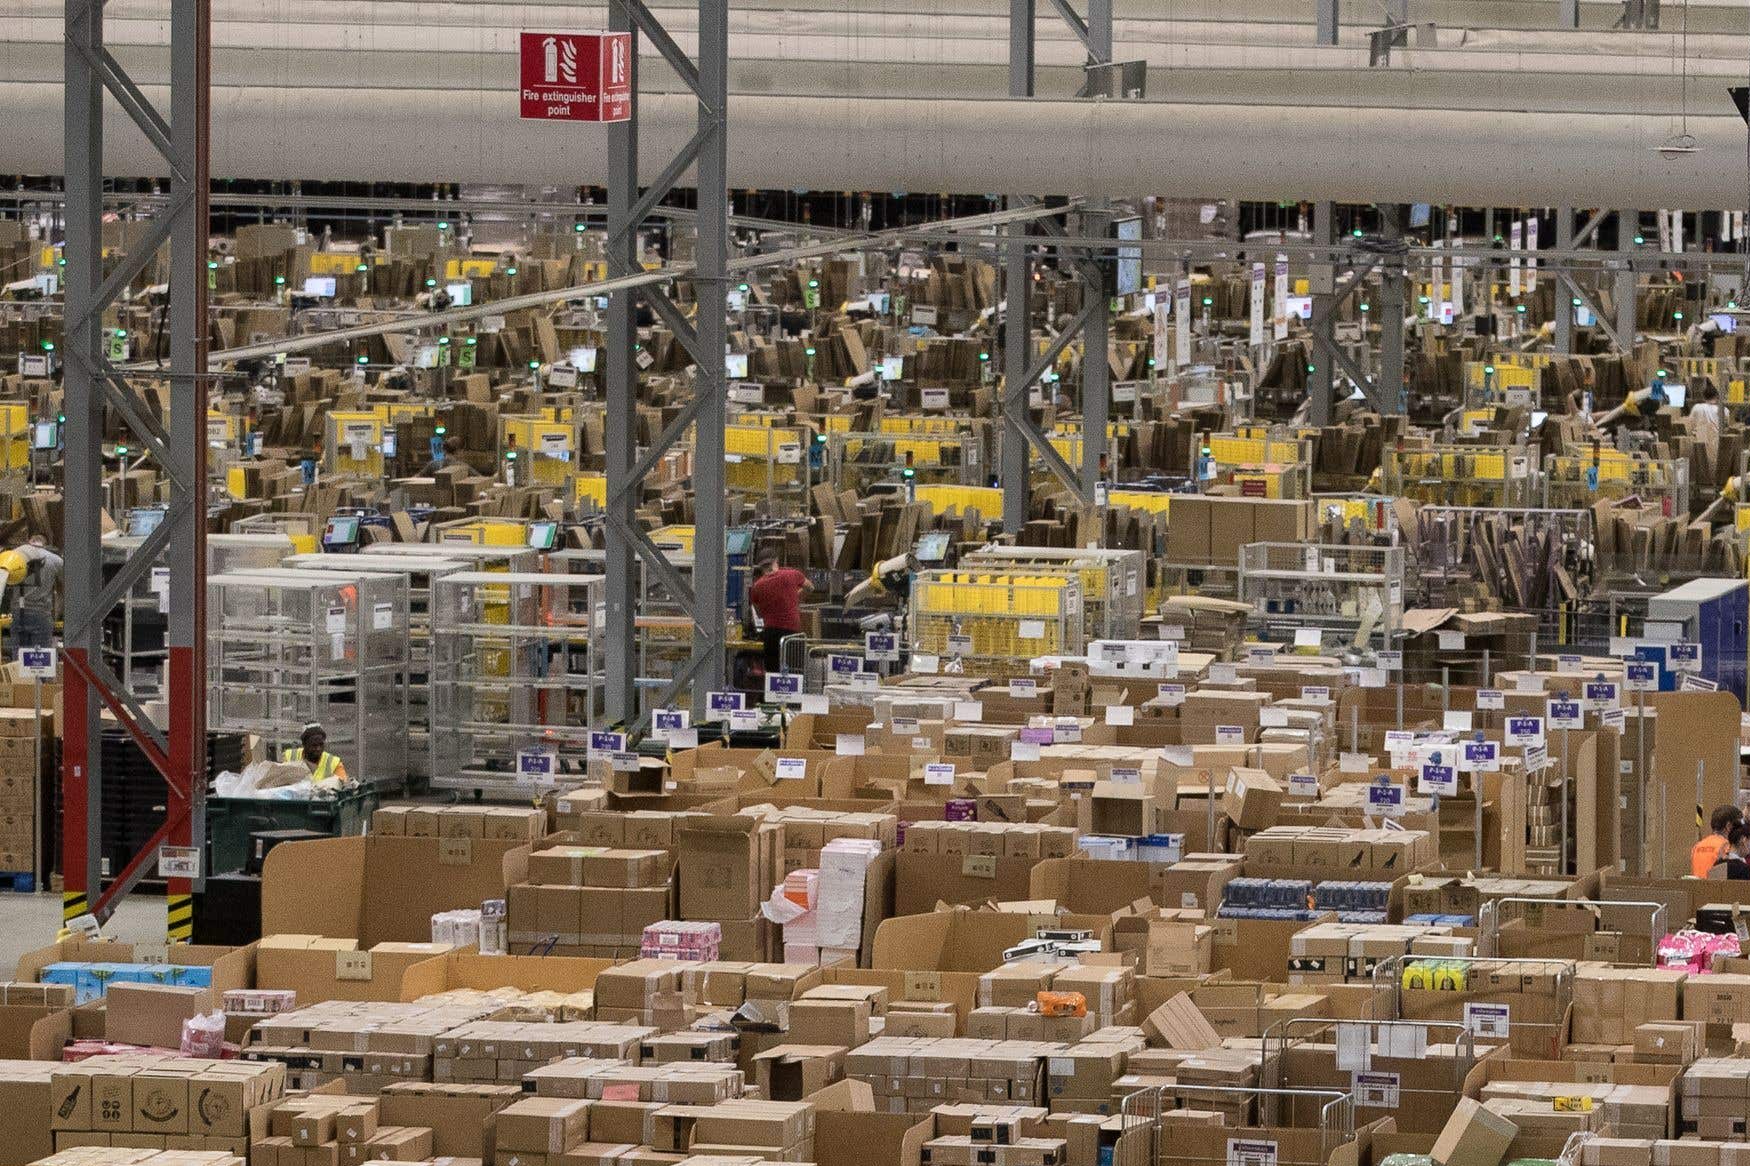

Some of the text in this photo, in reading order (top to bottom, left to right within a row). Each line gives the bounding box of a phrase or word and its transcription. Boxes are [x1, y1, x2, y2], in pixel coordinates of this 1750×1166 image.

[523, 90, 597, 104] Fire extinguisher
[548, 105, 571, 116] point
[463, 350, 471, 362] S
